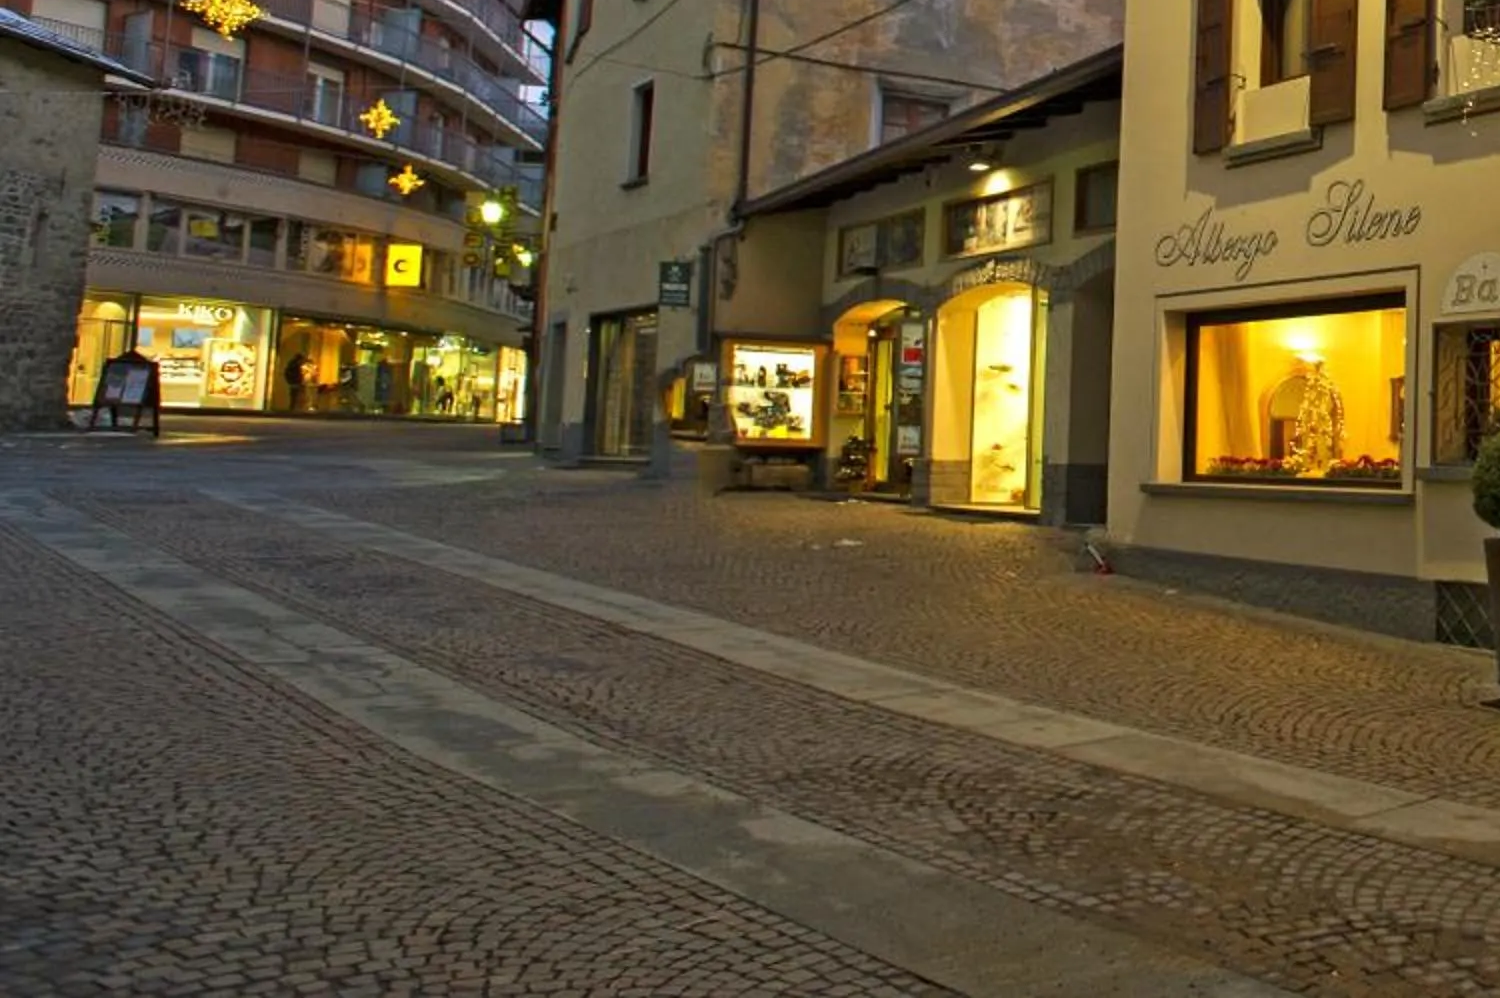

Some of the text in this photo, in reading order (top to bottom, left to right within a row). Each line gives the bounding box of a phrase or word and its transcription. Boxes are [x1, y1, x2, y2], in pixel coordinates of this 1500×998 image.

[1155, 178, 1422, 281] Albergo Silene
[178, 302, 233, 322] KIKO
